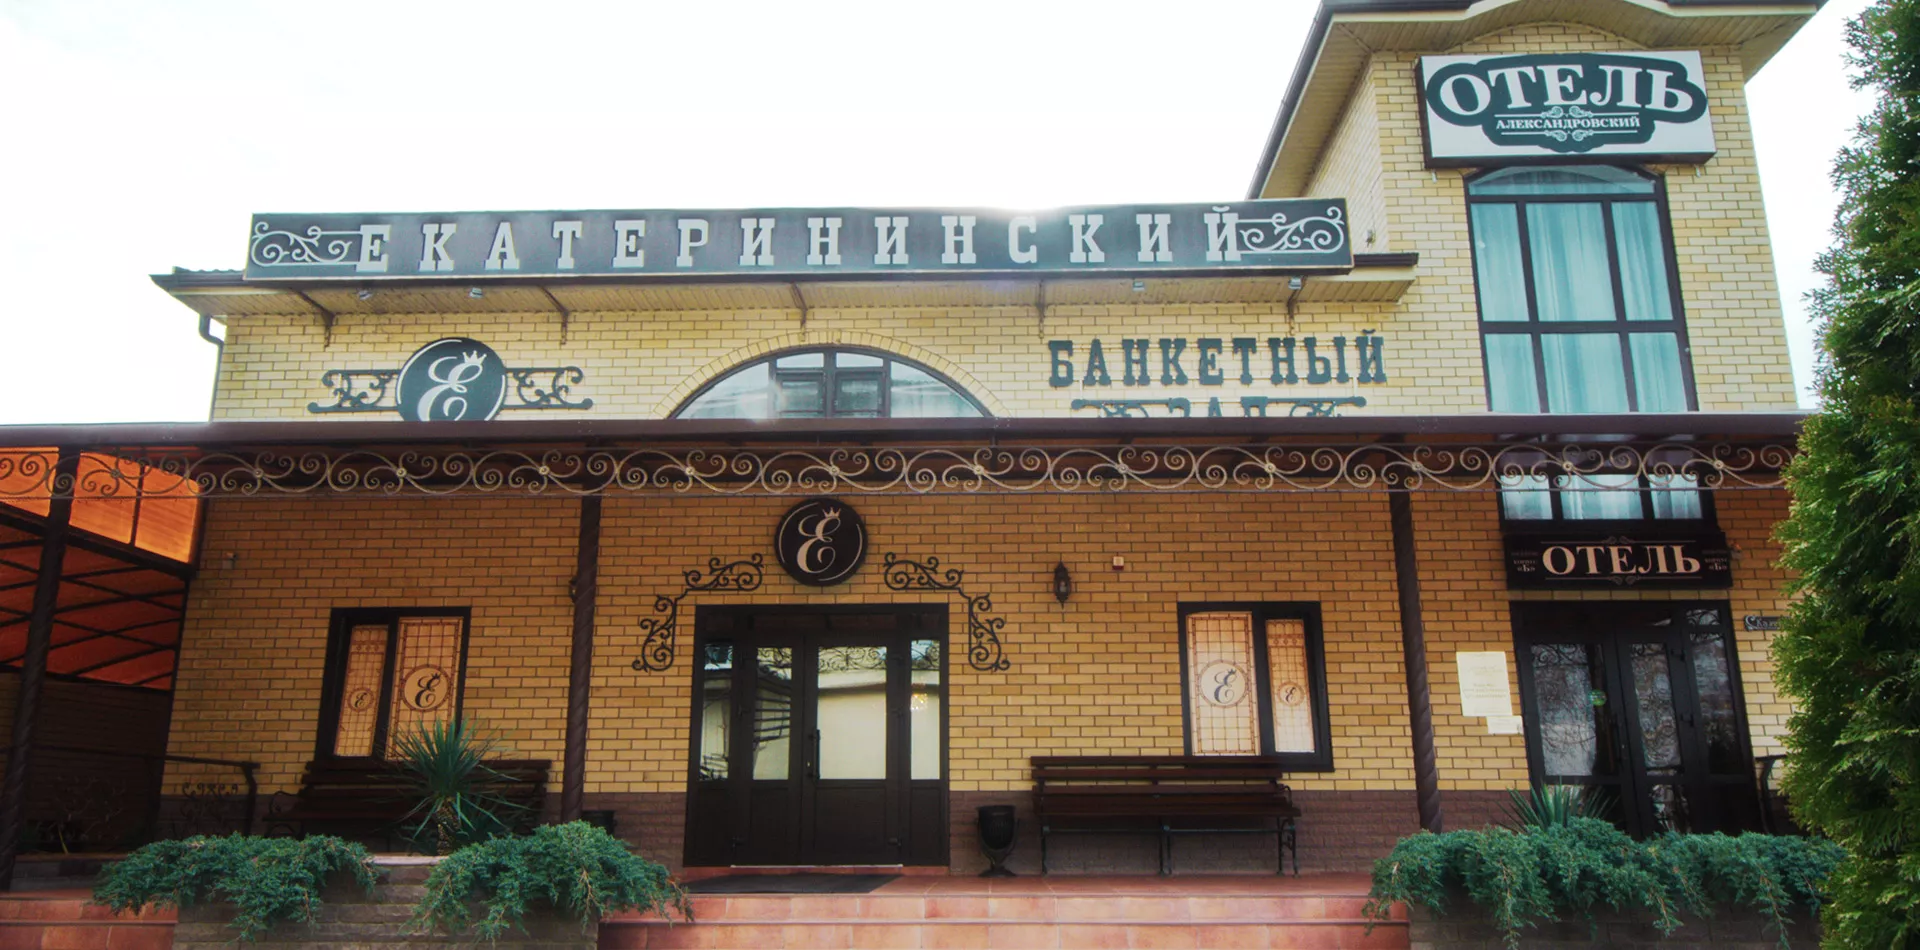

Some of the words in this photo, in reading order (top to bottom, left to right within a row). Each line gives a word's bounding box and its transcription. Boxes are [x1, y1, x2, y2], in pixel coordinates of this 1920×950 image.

[1440, 64, 1693, 115] ОТЕЛЬ
[1496, 116, 1641, 129] АЛЕКСАНДРОВСКИЙ
[355, 205, 1242, 273] ЕКАТЕРИНИНСКИЙ
[1048, 329, 1387, 387] БАНКЕТНЫЙ
[1542, 545, 1701, 575] ОТЕЛЬ
